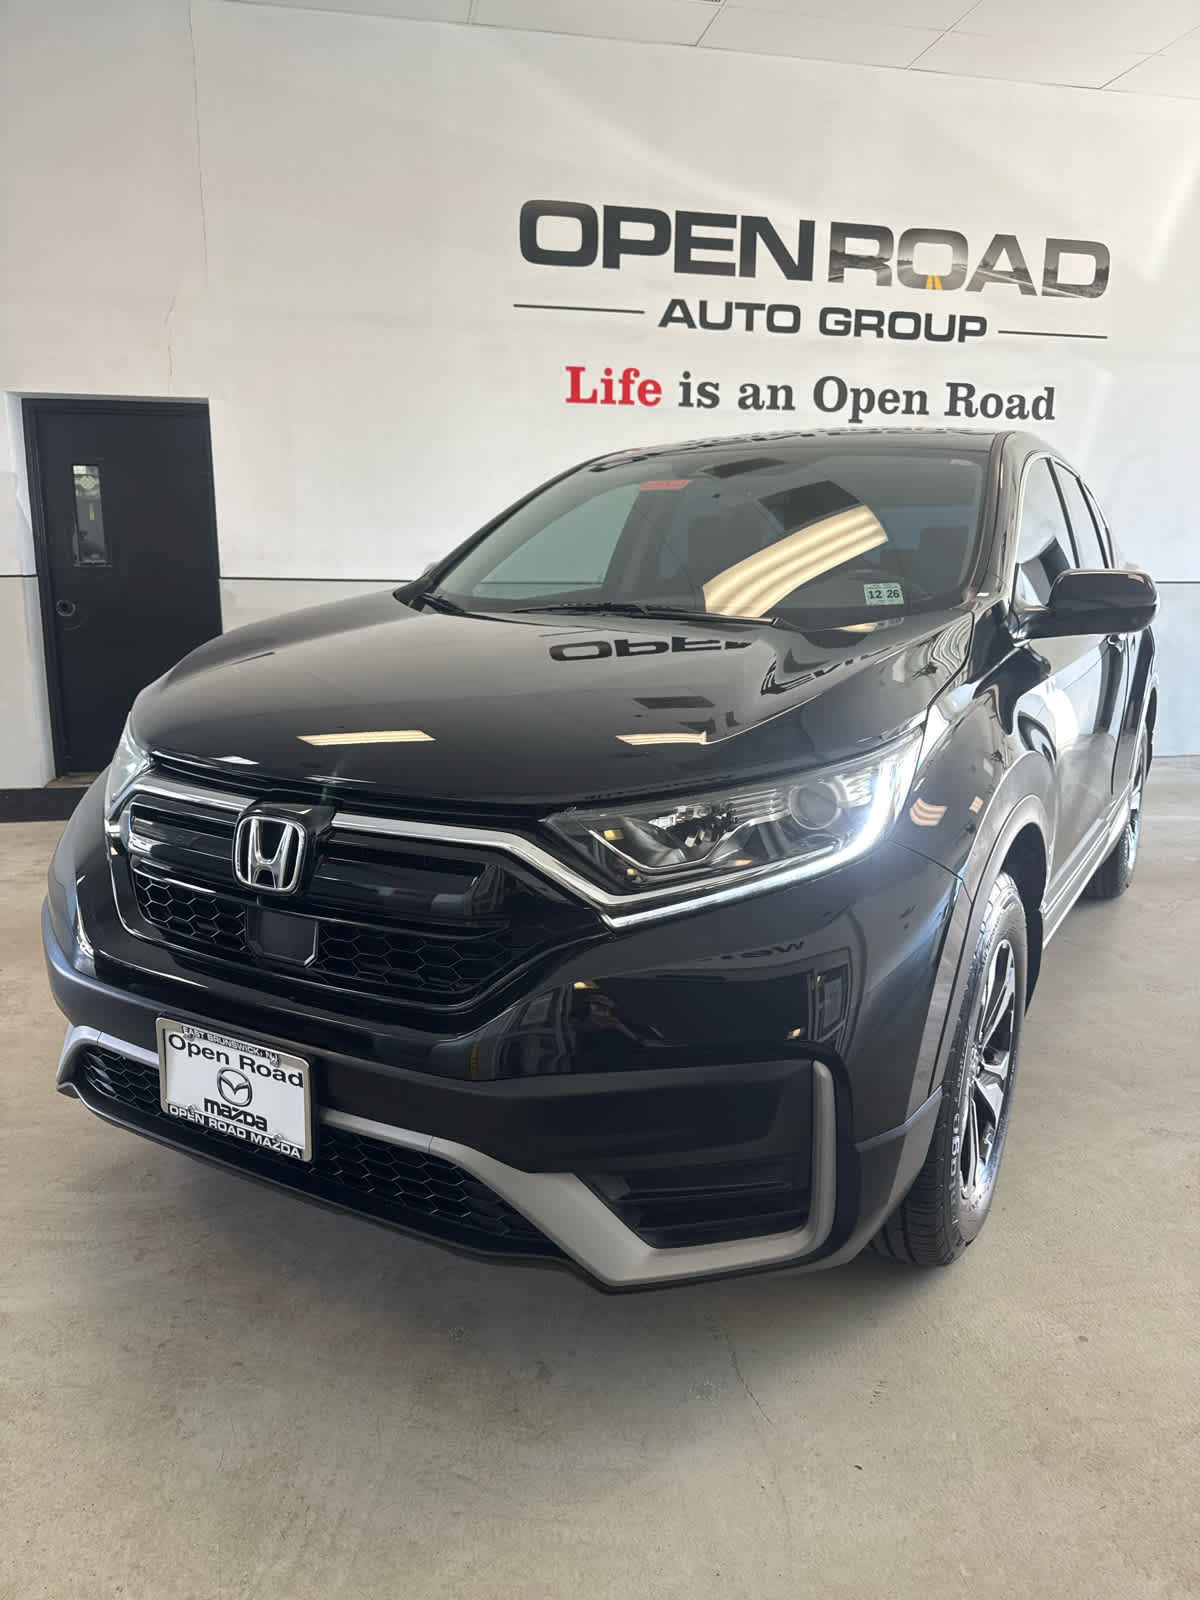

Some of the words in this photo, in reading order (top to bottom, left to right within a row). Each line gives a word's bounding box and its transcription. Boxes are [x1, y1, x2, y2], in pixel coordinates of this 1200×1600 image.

[519, 199, 816, 282] OPEN
[828, 221, 1111, 299] ROAD
[658, 298, 801, 334] AUTO
[818, 306, 988, 343] GROUP
[565, 366, 663, 407] Life
[678, 371, 720, 408] is
[737, 382, 796, 411] an
[813, 376, 930, 424] Open
[943, 382, 1056, 421] Road
[869, 590, 882, 600] 12
[886, 589, 900, 599] 26
[168, 1034, 230, 1065] Open
[239, 1054, 304, 1088] Road
[169, 1105, 205, 1125] OPEN
[208, 1117, 246, 1138] ROAD
[250, 1132, 301, 1159] MAZDA
